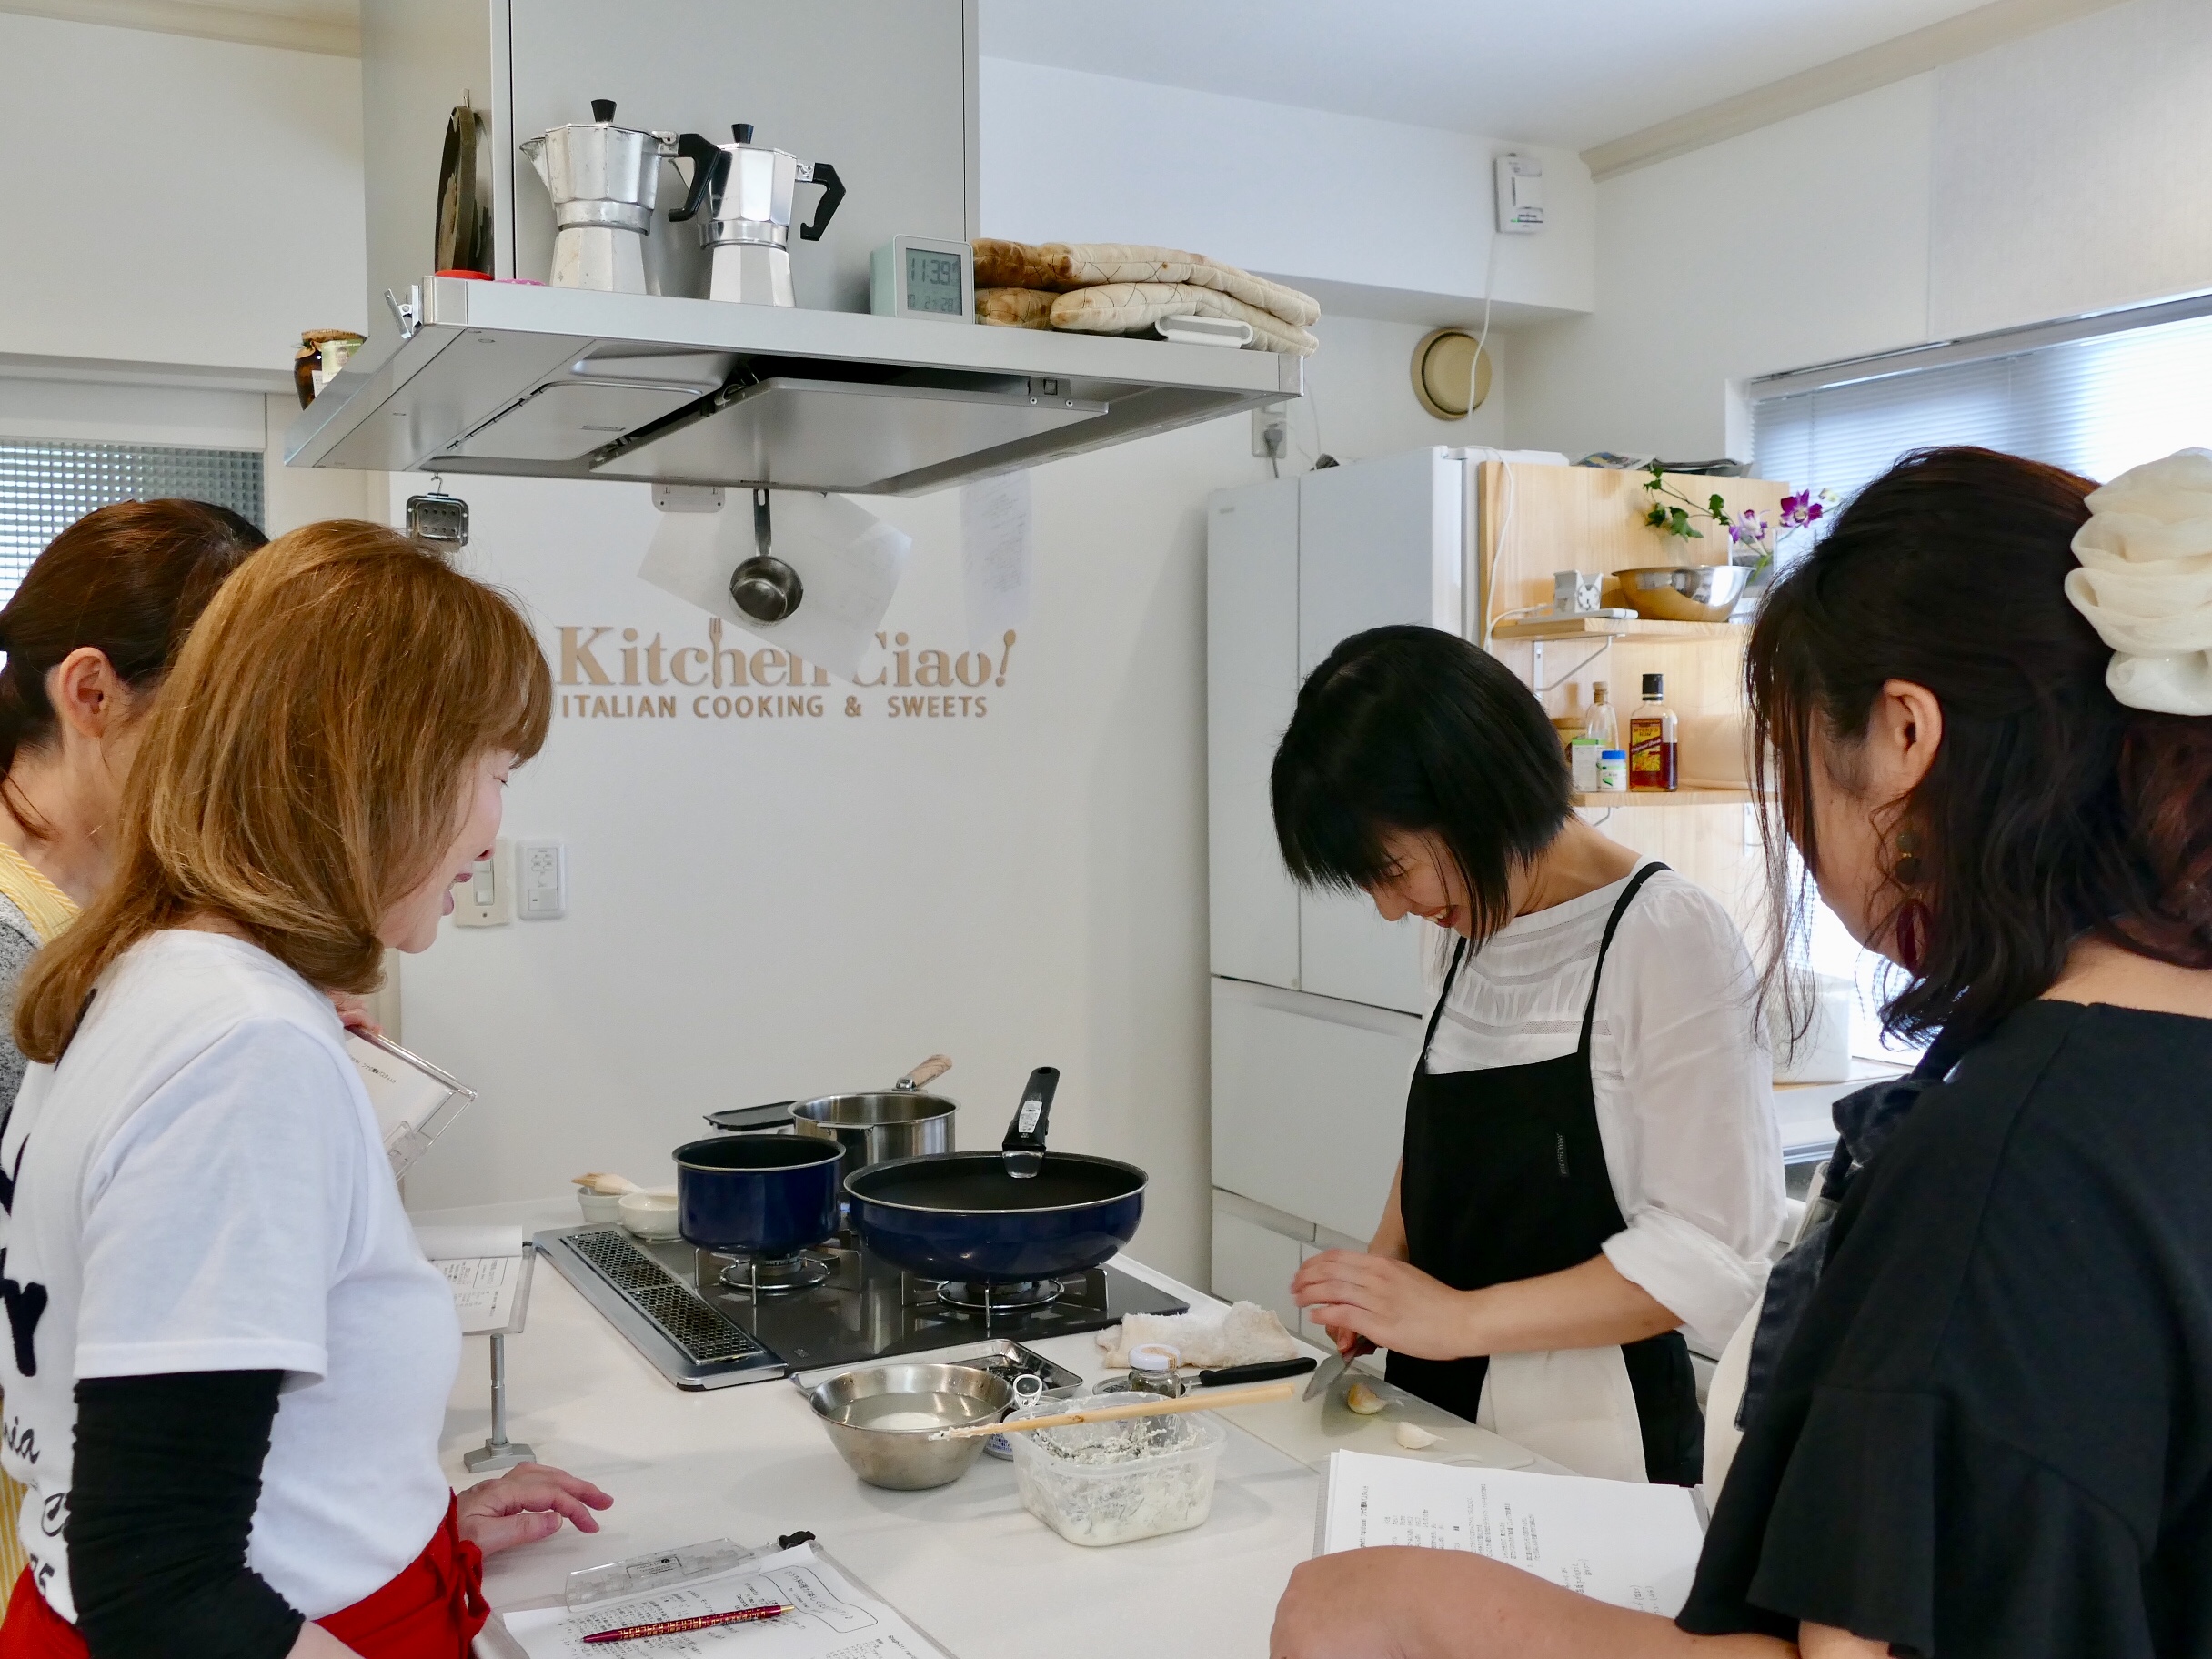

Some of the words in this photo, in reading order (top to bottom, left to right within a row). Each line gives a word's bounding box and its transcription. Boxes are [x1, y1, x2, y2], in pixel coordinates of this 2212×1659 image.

[910, 257, 951, 286] 11:39
[555, 618, 831, 689] Kitchen
[562, 694, 677, 719] ITALIAN
[692, 694, 824, 719] COOKING
[844, 695, 862, 718] &
[887, 695, 988, 719] SWEETS
